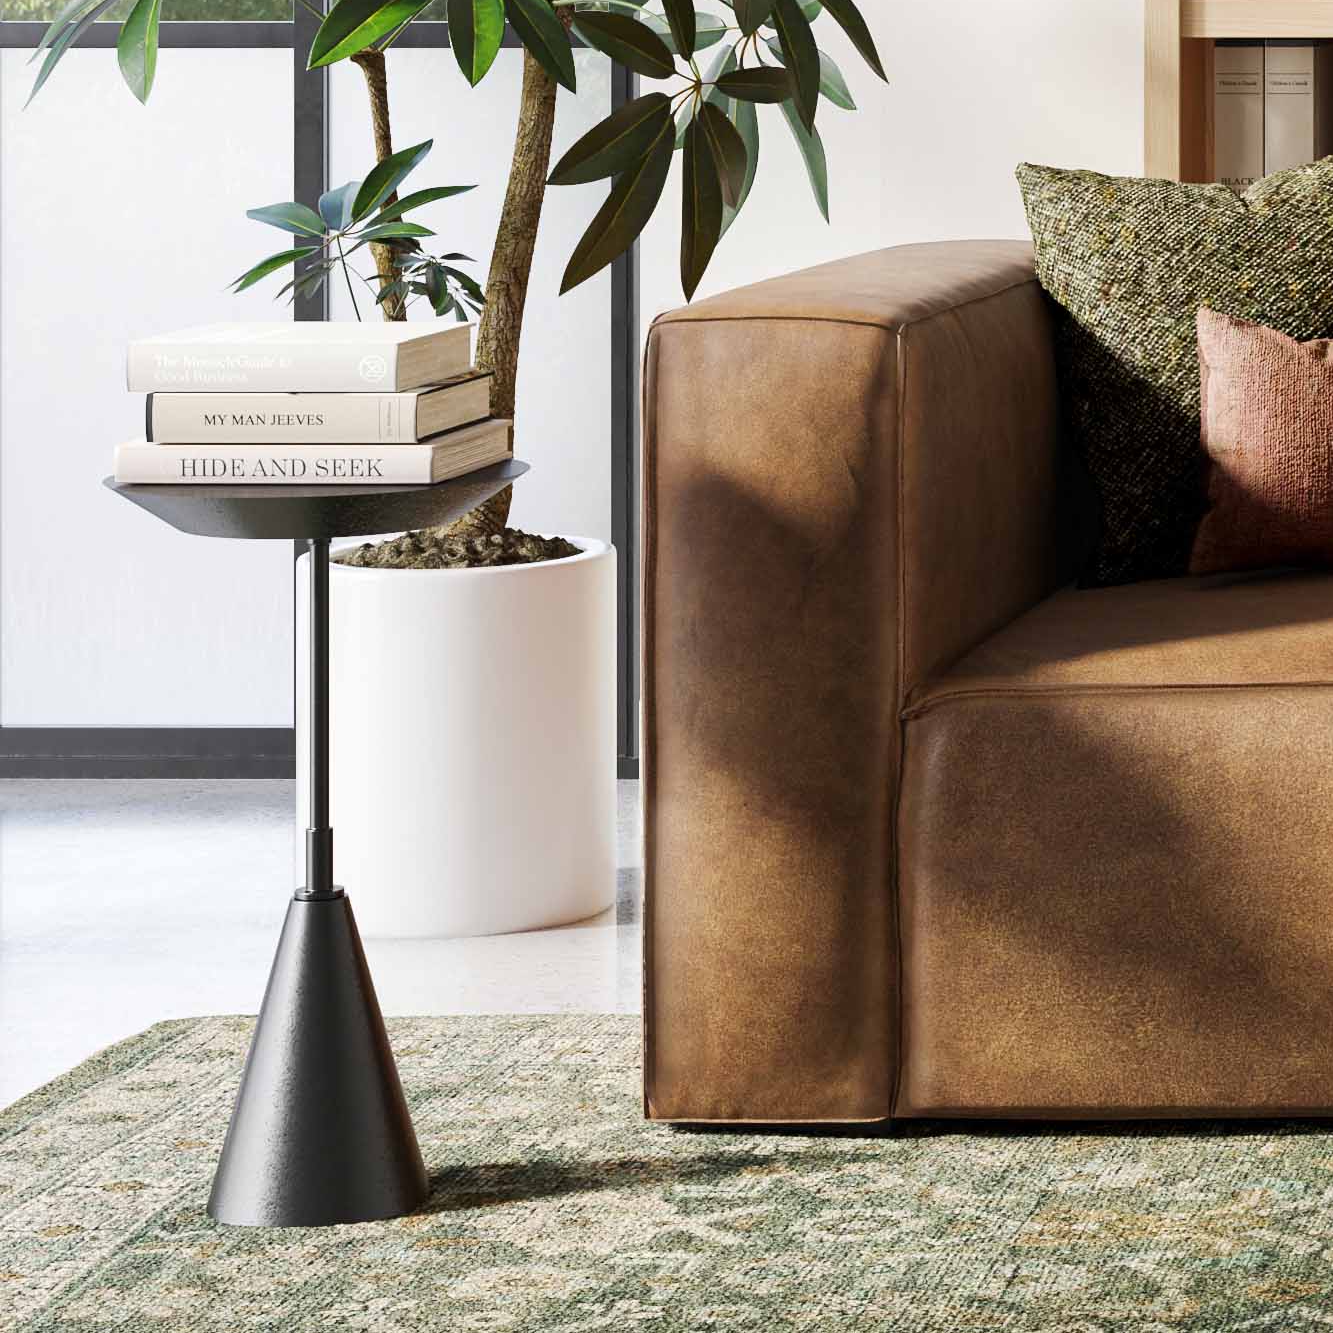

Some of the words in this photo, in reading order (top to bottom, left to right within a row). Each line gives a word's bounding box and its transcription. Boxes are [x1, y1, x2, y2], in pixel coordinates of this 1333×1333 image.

[1220, 177, 1254, 186] BLACK
[203, 414, 227, 426] MY
[232, 414, 267, 426] MAN
[270, 414, 324, 426] JEEVES
[179, 458, 246, 478] HIDE
[252, 458, 307, 478] AND
[315, 458, 385, 478] SEEK
